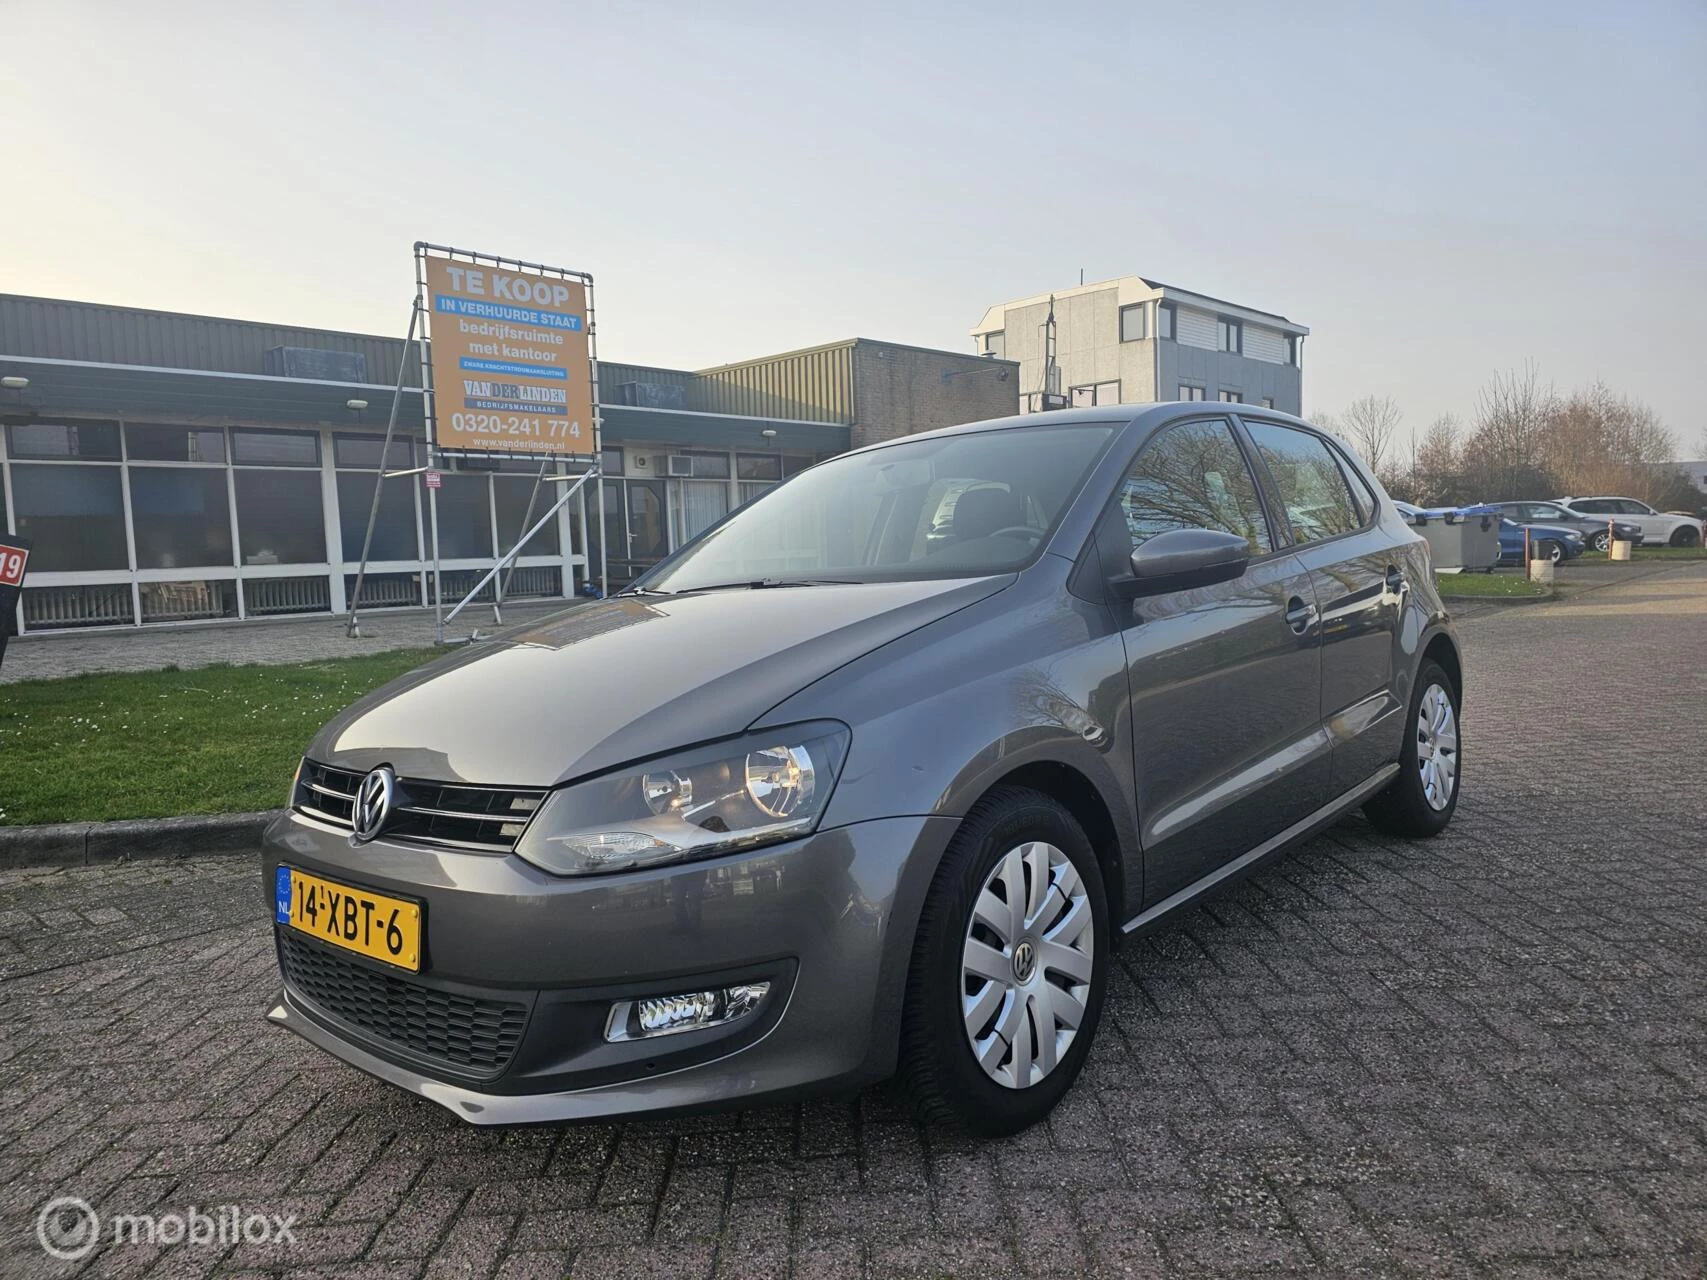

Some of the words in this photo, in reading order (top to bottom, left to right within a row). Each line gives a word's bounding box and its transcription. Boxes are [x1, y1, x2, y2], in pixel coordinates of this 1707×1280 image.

[446, 266, 485, 296] TE
[492, 275, 569, 308] KOOP
[441, 298, 456, 312] IN
[458, 302, 538, 324] VERHUURDE
[540, 313, 577, 330] STAAT
[459, 319, 564, 346] bedrijfsruimte
[469, 341, 499, 356] met
[502, 343, 557, 363] kantoor
[476, 401, 557, 413] BEDRIJFSMAKELAARS
[451, 412, 541, 436] 0320-241
[547, 419, 581, 438] 774
[472, 438, 565, 450] www.vanderlinden.nl
[278, 900, 291, 914] NL
[298, 881, 403, 956] 14-XBT-6
